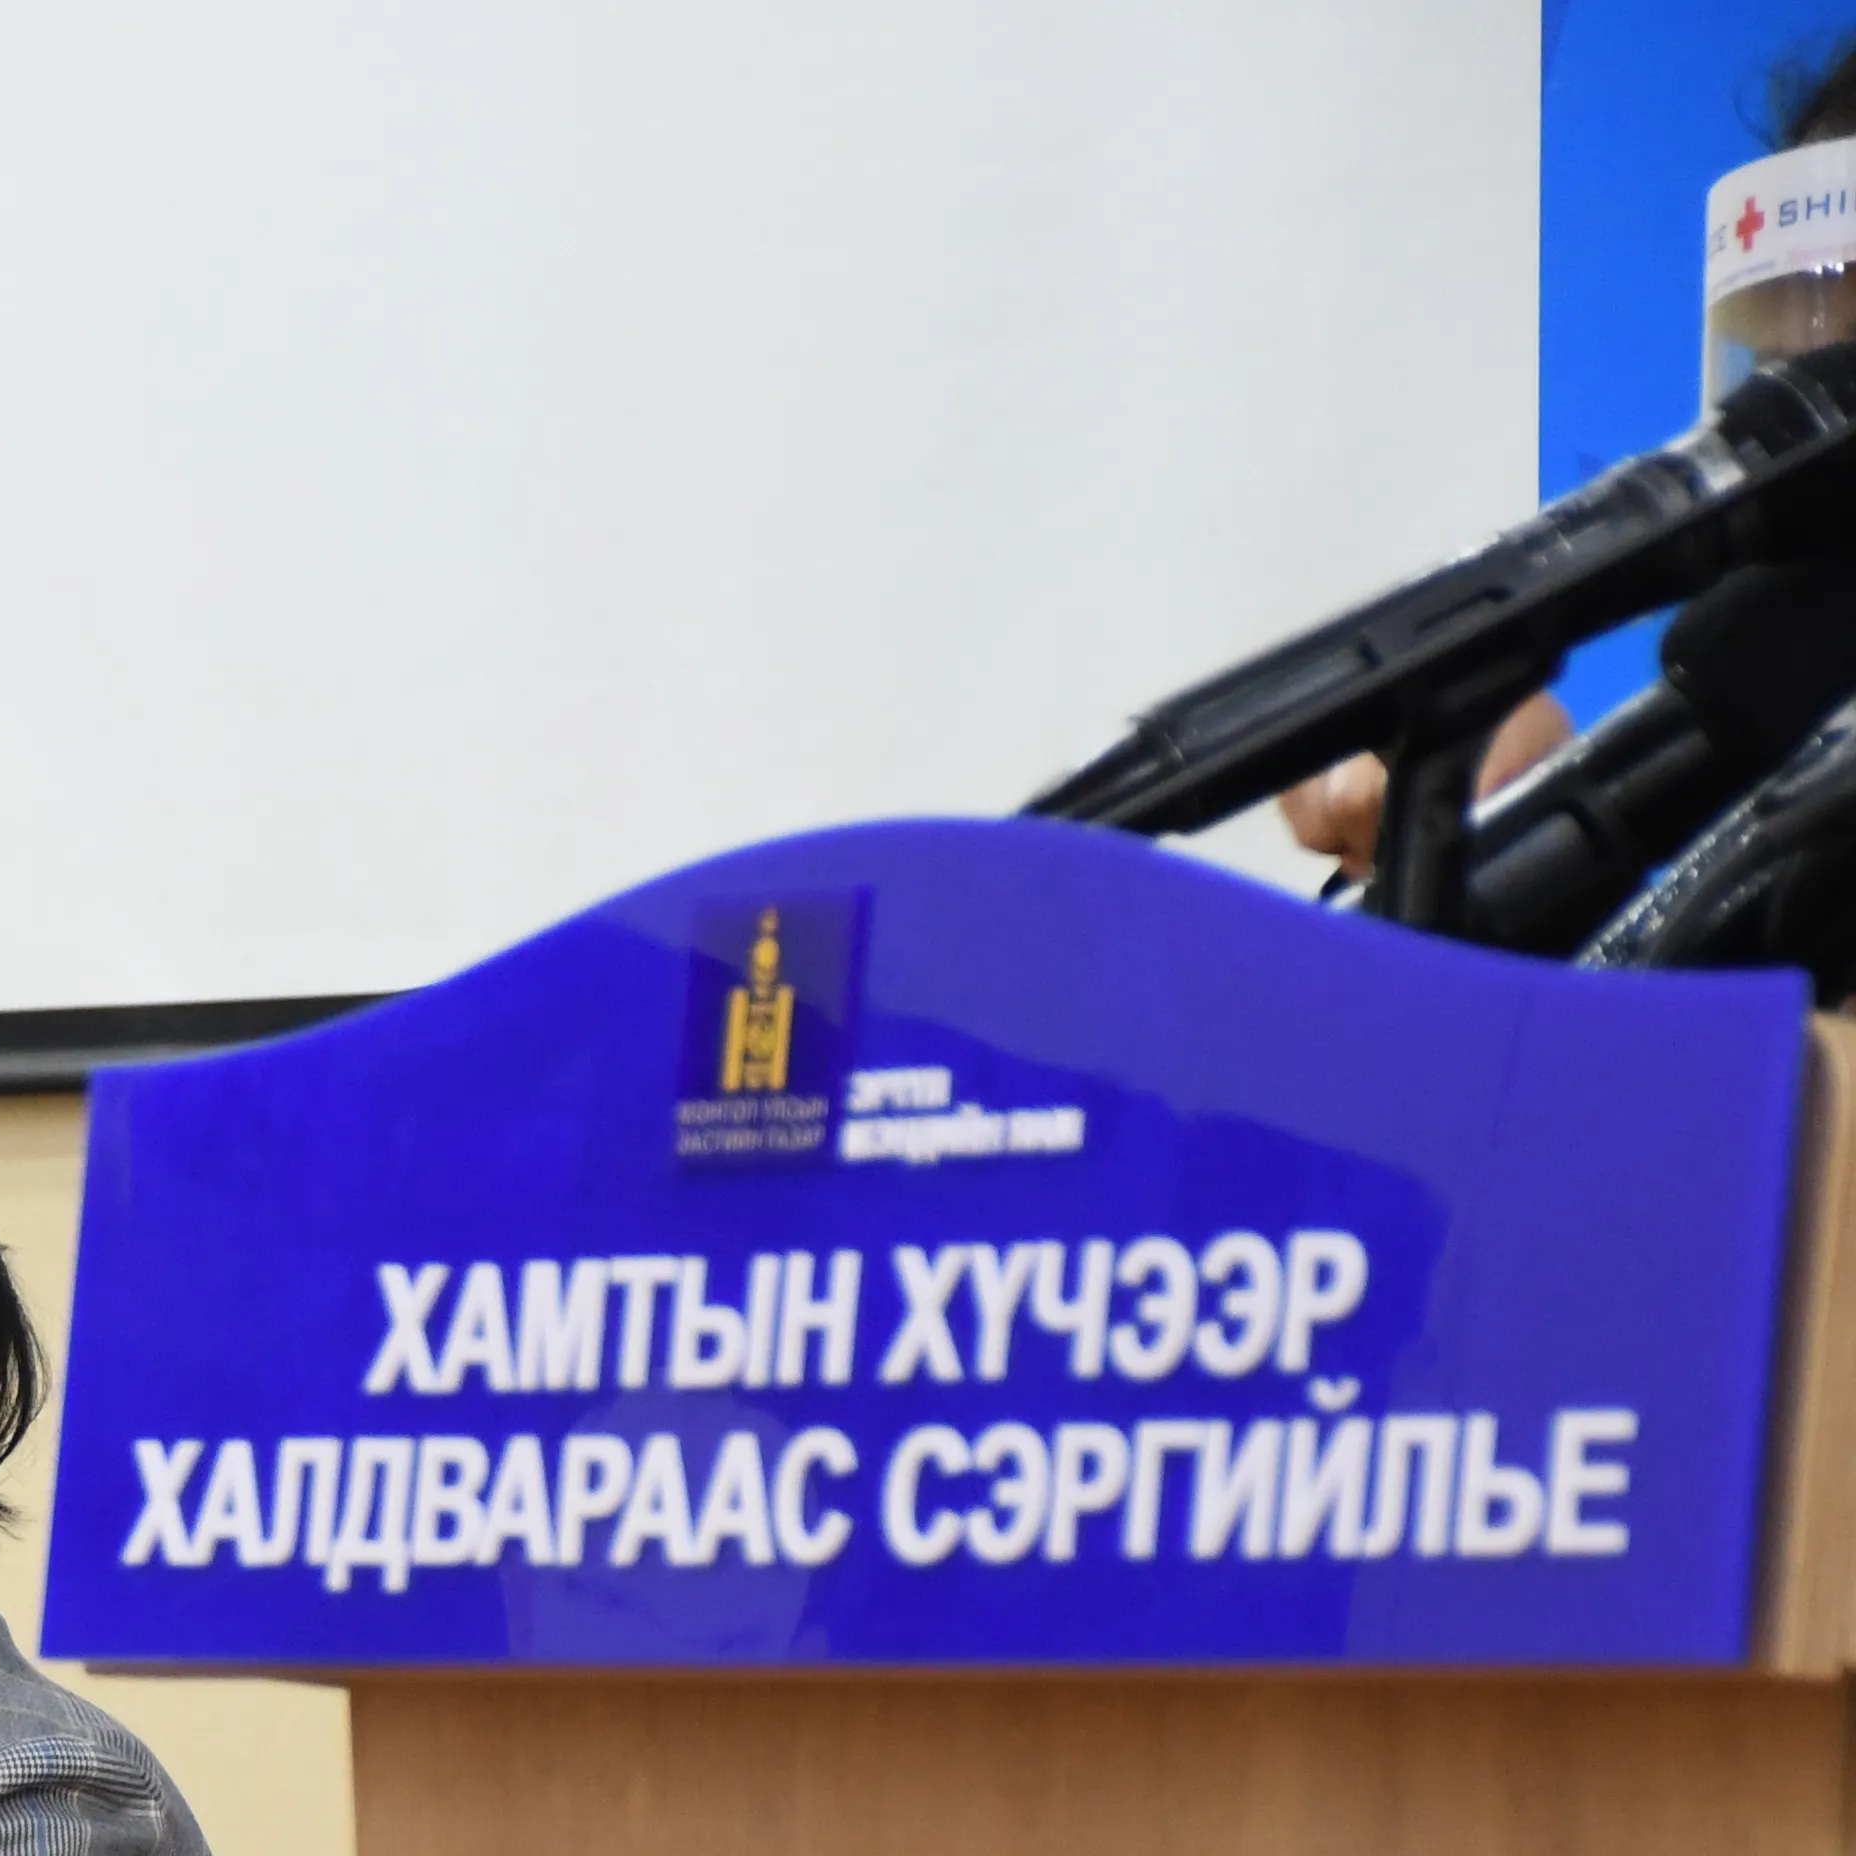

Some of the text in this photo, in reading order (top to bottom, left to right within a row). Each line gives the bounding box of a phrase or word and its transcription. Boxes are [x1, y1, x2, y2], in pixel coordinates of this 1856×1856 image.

[1778, 188, 1856, 228] SHI
[363, 1229, 1370, 1395] ХАМТЫН ХҮЧЭЭР
[120, 1378, 1640, 1594] ХАЛДВАРААС СЭРГИЙЛЬЕ
